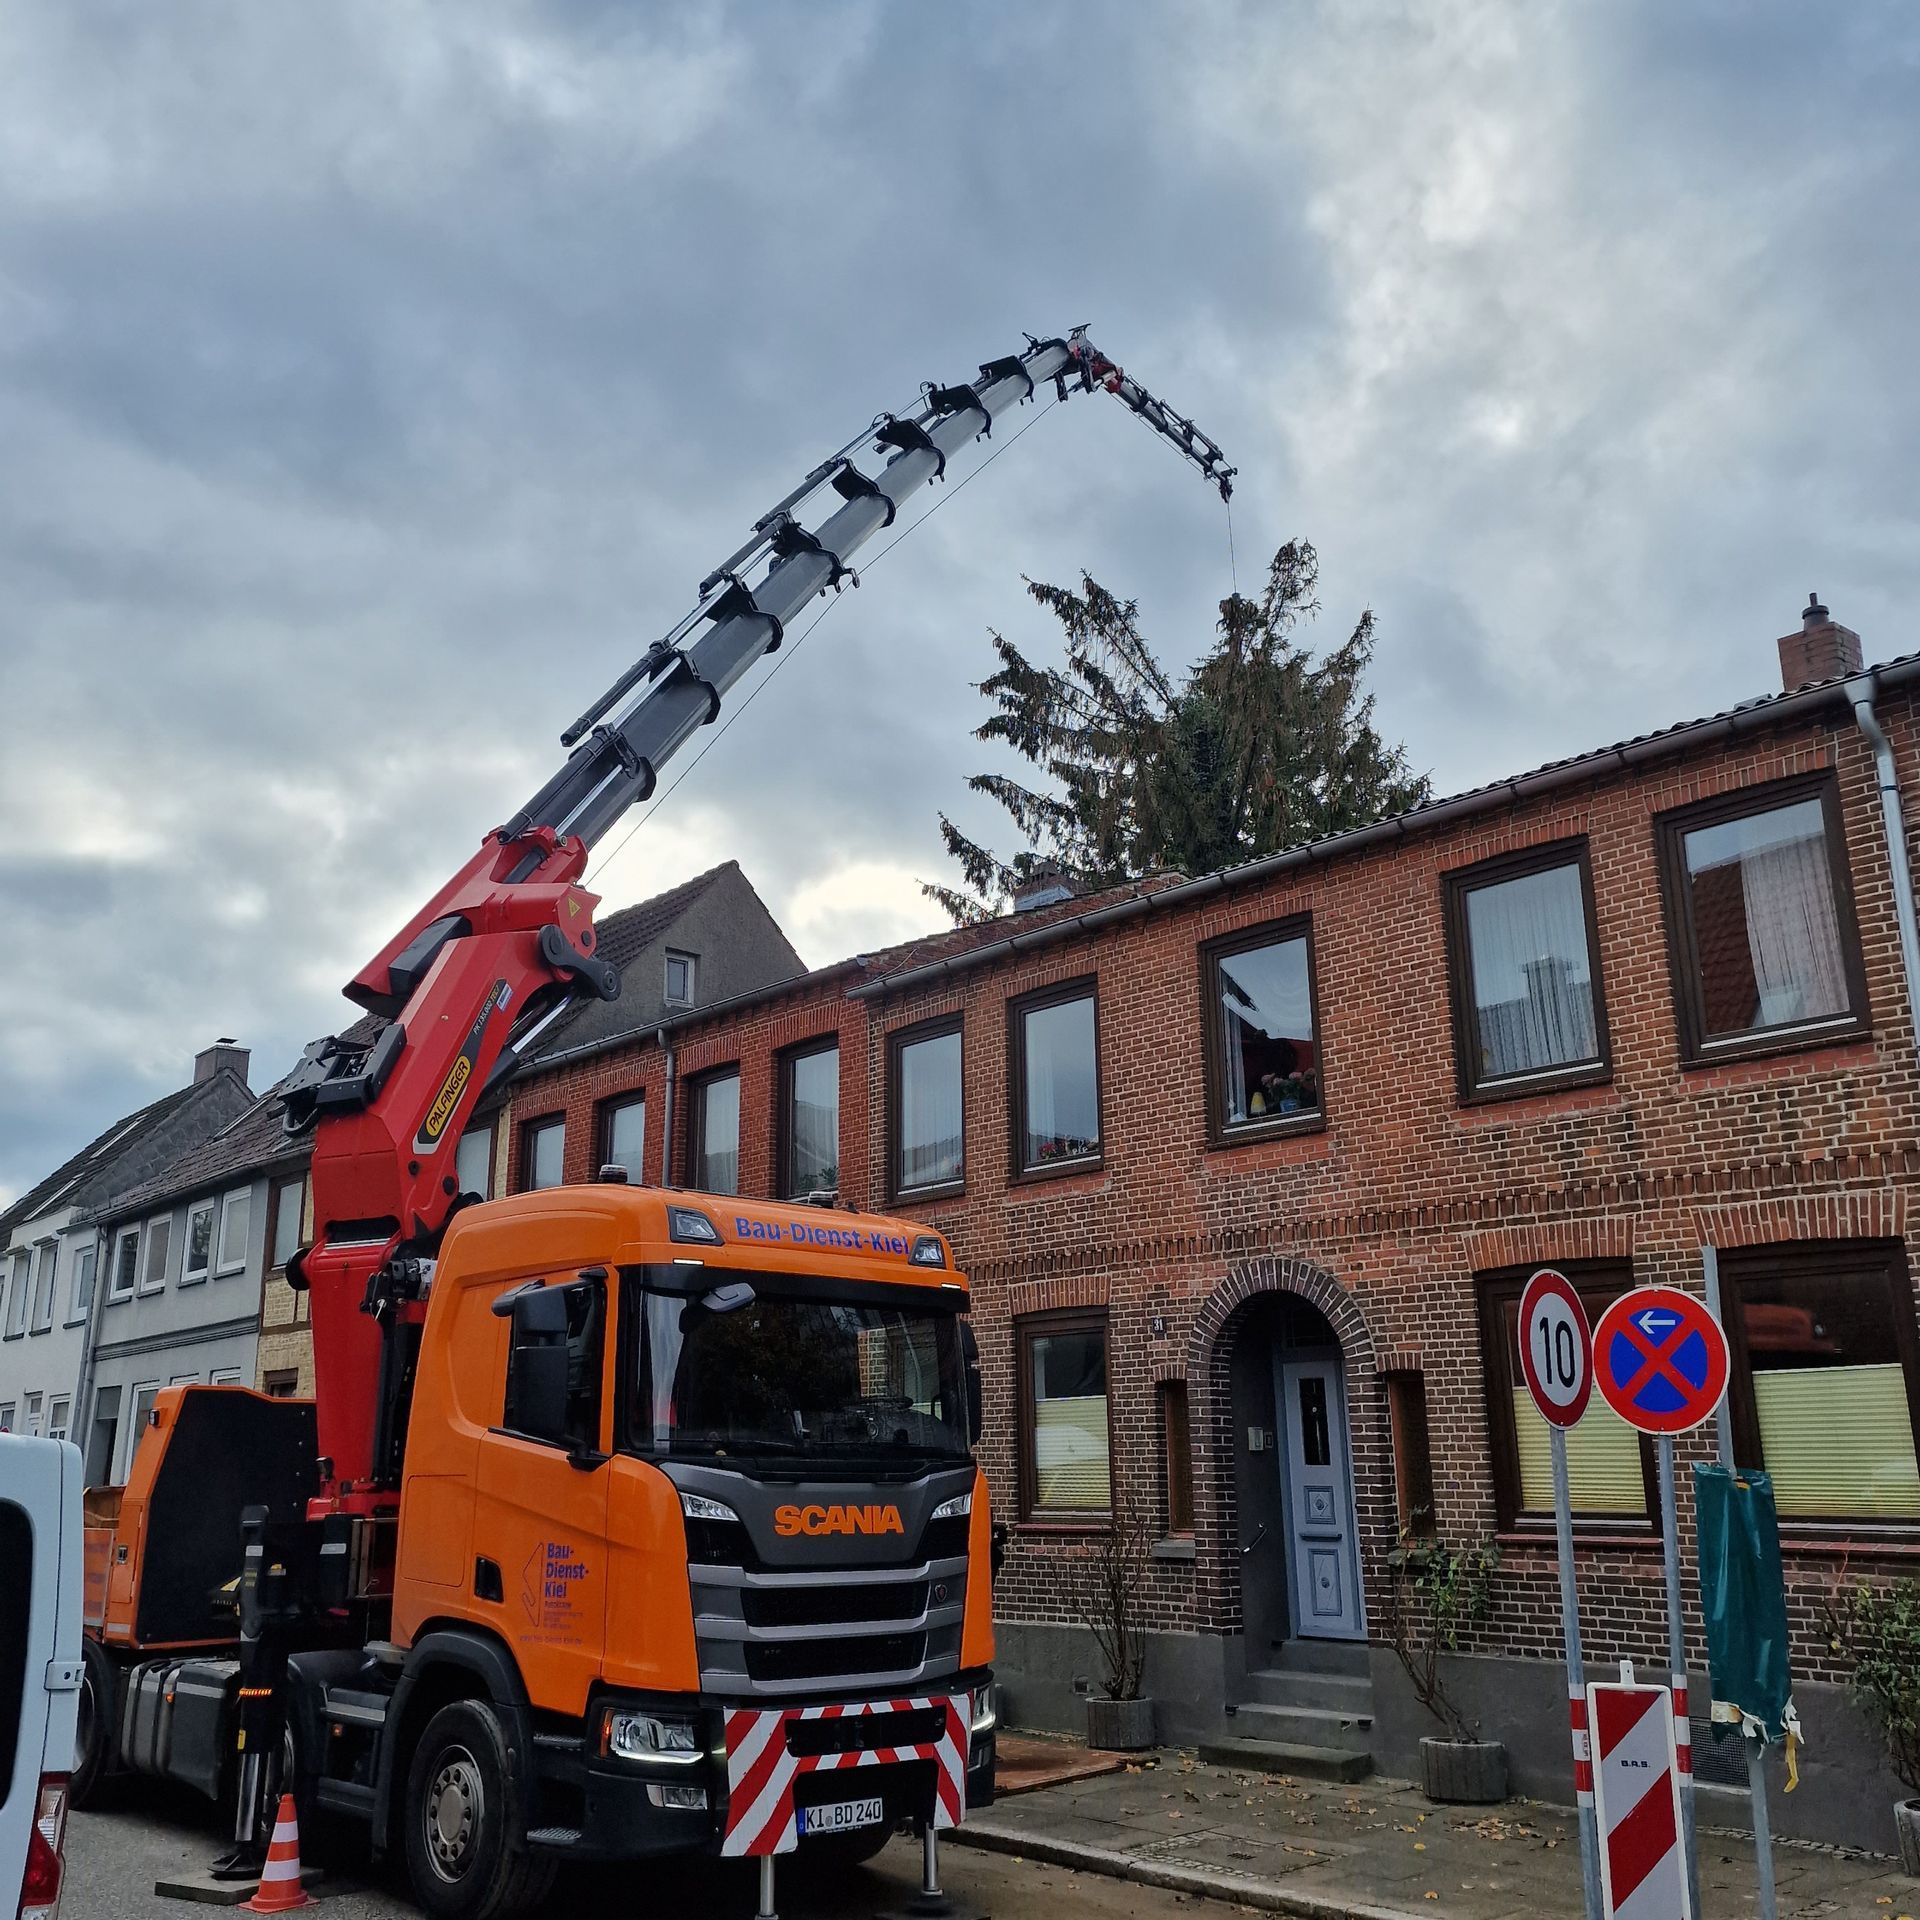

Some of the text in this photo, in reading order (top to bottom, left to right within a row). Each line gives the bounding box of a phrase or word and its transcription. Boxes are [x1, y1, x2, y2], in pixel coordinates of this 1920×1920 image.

[429, 1060, 468, 1131] PALFINGER
[735, 1217, 910, 1255] Bau-Dienst-Kiel
[1539, 1316, 1576, 1388] 10
[774, 1504, 905, 1536] SCANIA
[547, 1542, 574, 1559] Bau-
[545, 1561, 589, 1580] Dienst-
[544, 1581, 567, 1598] Kiel
[806, 1808, 824, 1829] KI
[835, 1804, 853, 1825] BD
[856, 1800, 881, 1822] 240
